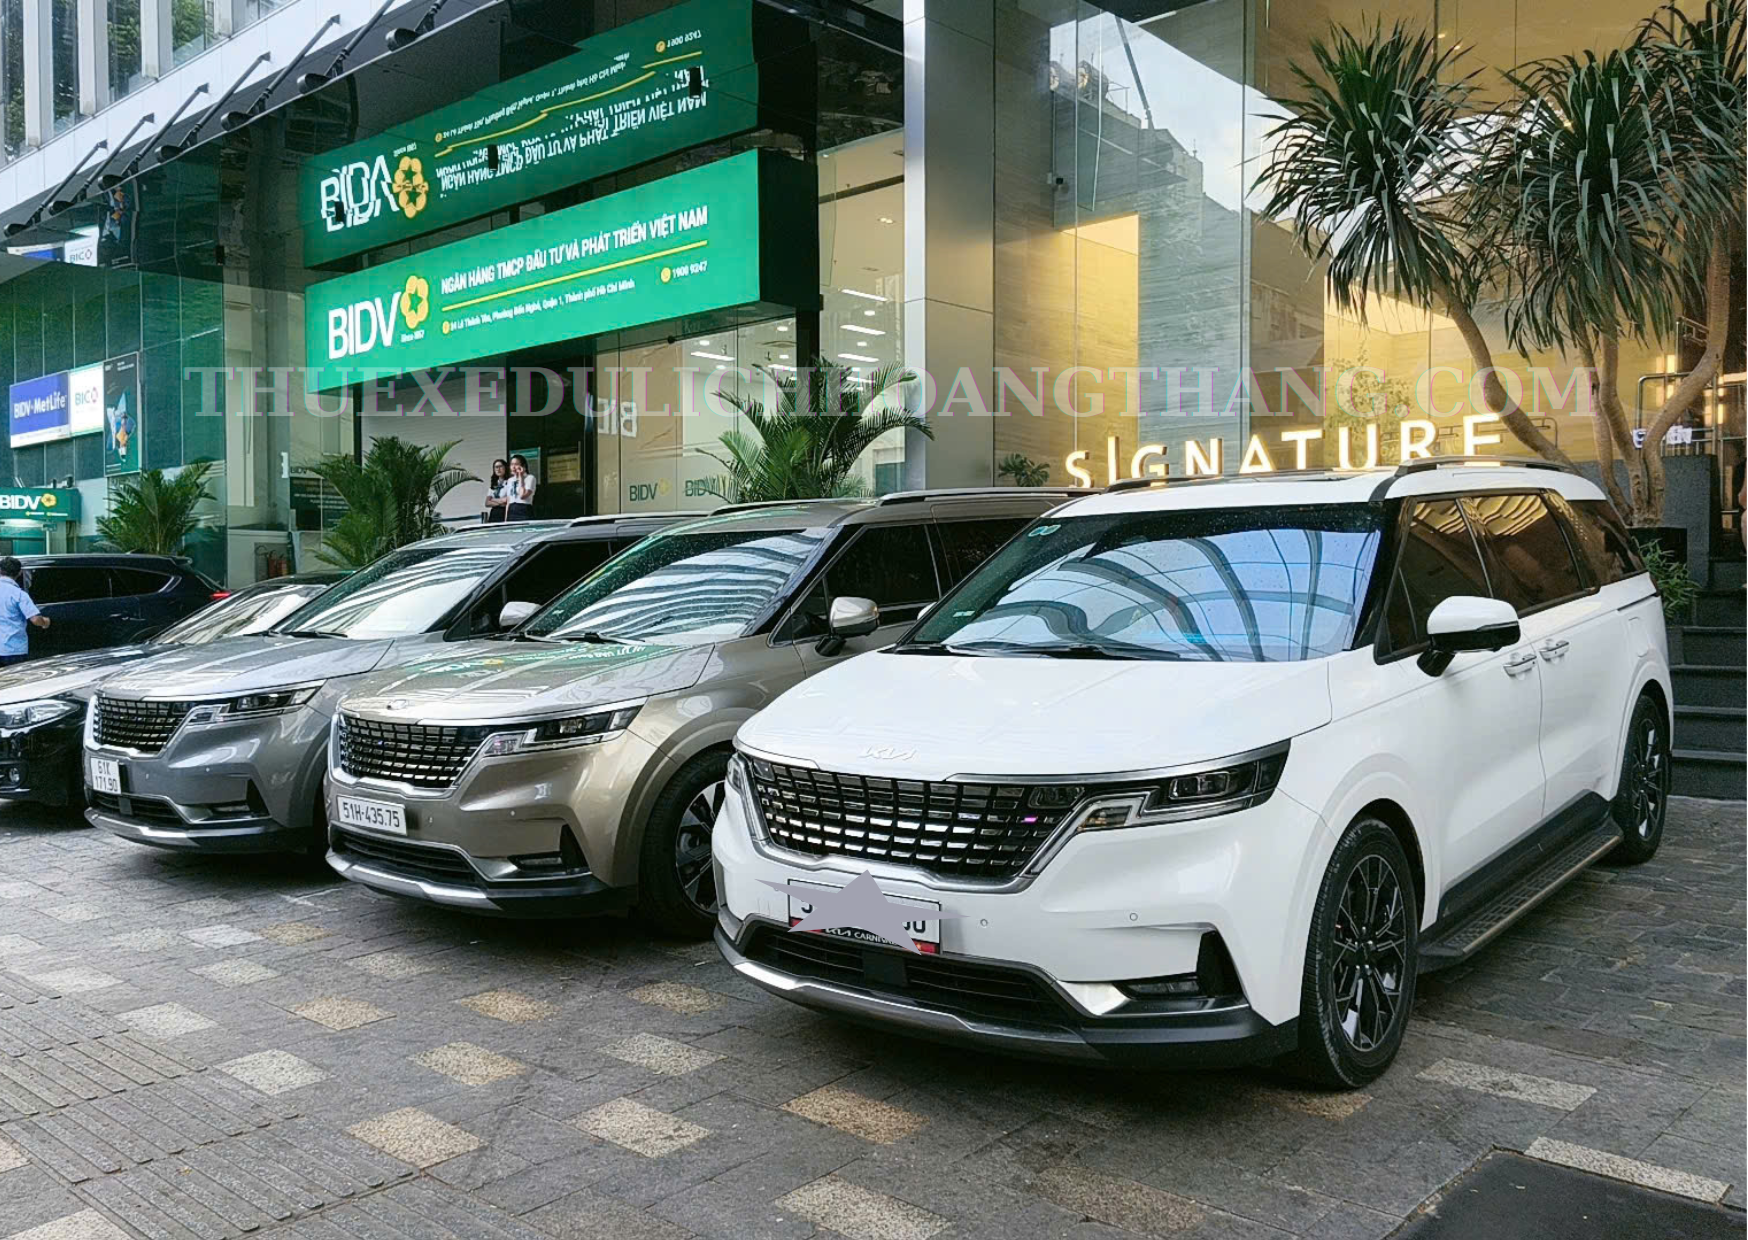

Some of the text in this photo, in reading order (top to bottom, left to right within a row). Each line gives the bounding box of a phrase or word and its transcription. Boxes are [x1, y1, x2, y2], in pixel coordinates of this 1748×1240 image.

[441, 271, 468, 295] NGÂN
[468, 264, 496, 288] HÀNG
[497, 256, 525, 280] TMCP
[565, 238, 580, 261] VÀ
[581, 231, 611, 257] PHÁT
[649, 213, 677, 239] VIỆT
[678, 205, 708, 231] NAM
[328, 291, 402, 360] BIDV
[1064, 411, 1502, 491] SIGNATURE
[0, 494, 41, 510] BIDV
[629, 483, 658, 501] BIDV
[342, 802, 400, 828] 51H-435.75
